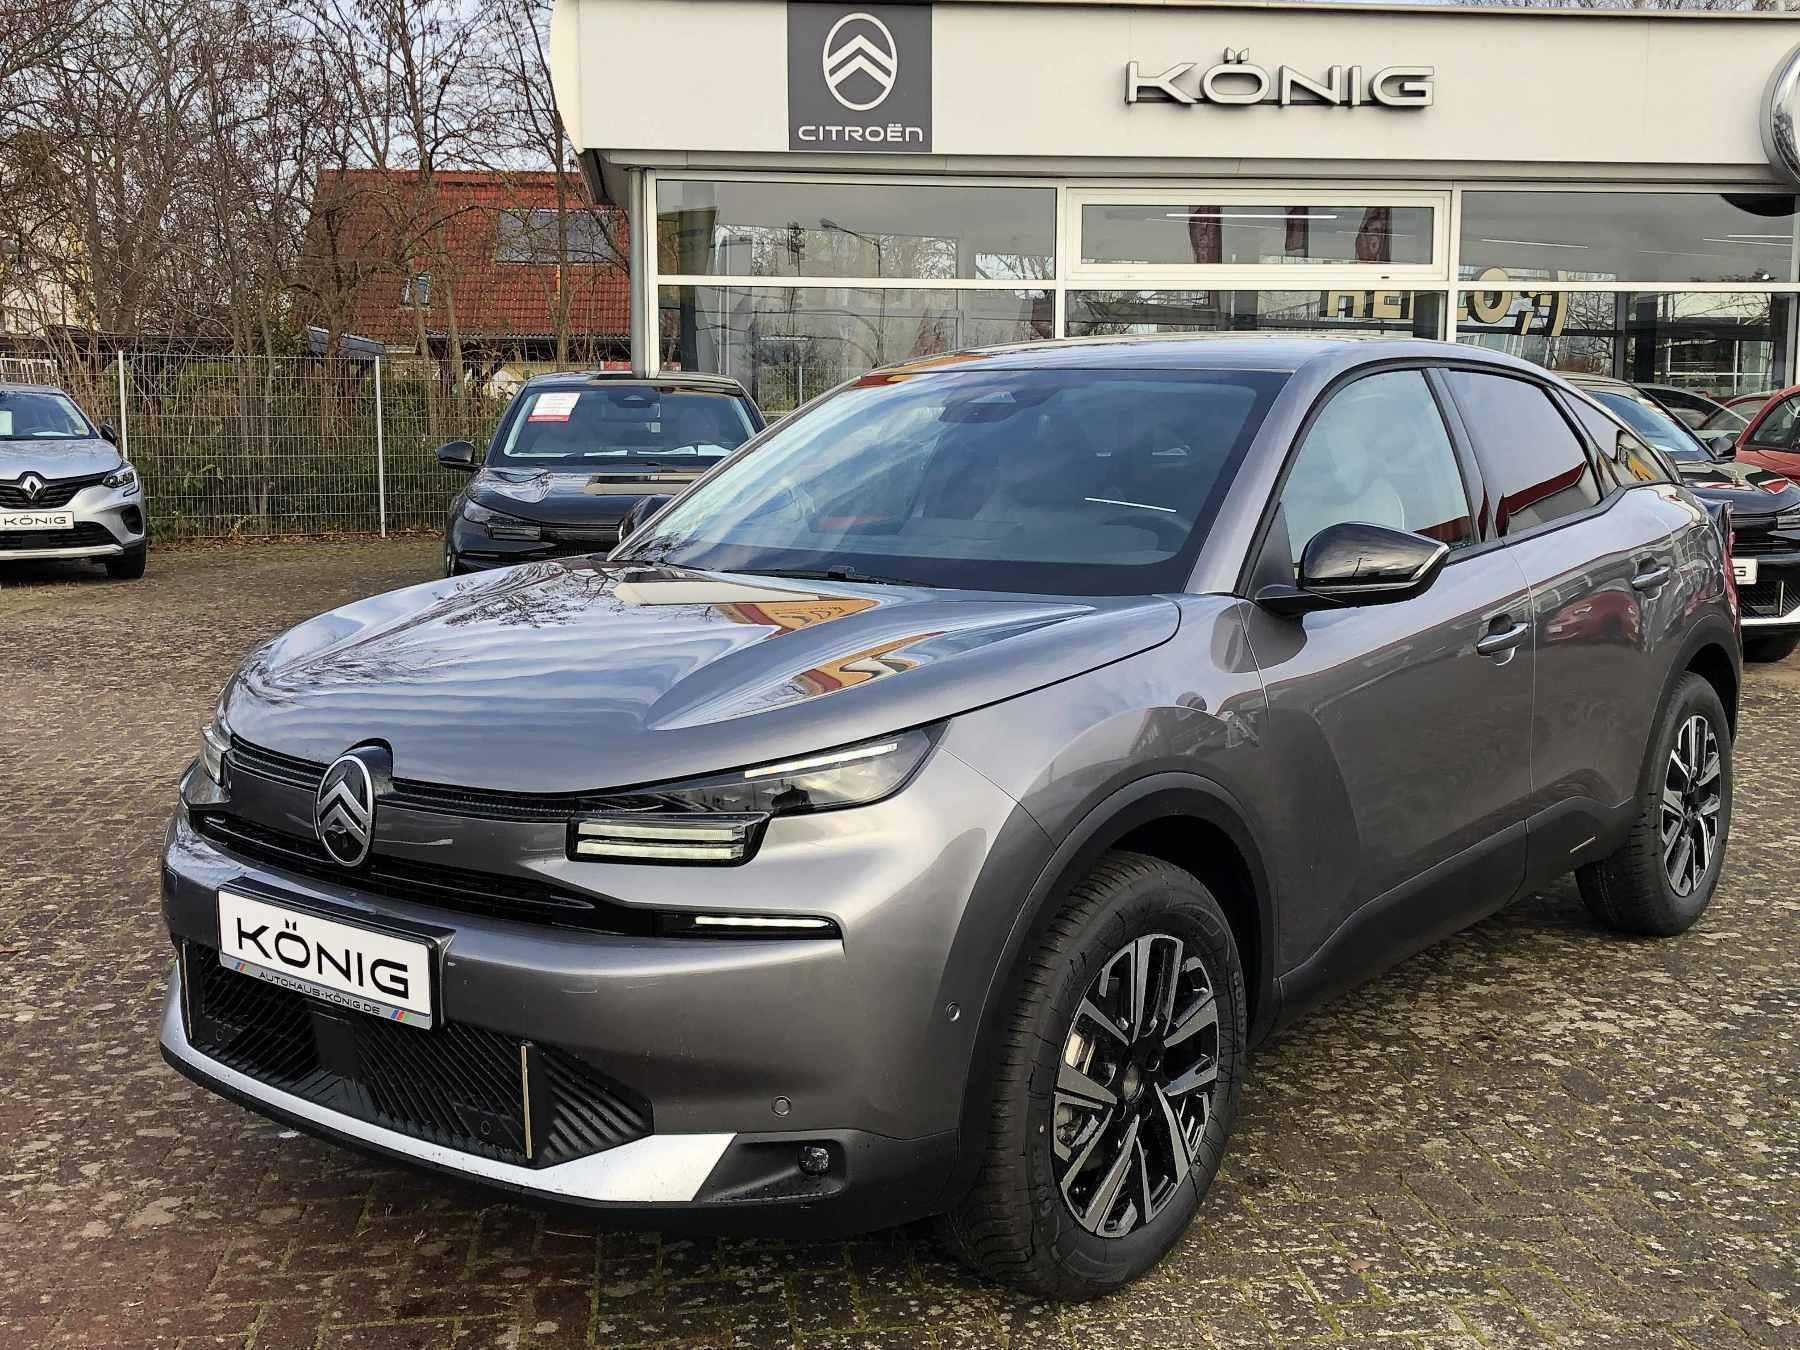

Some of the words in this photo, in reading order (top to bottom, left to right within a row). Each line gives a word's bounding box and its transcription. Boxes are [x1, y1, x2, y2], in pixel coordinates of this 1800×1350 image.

[1127, 47, 1435, 107] KÖNIG
[798, 123, 923, 142] CITROËN
[4, 514, 67, 526] KÖNIG
[236, 917, 410, 1000] KÖNIG
